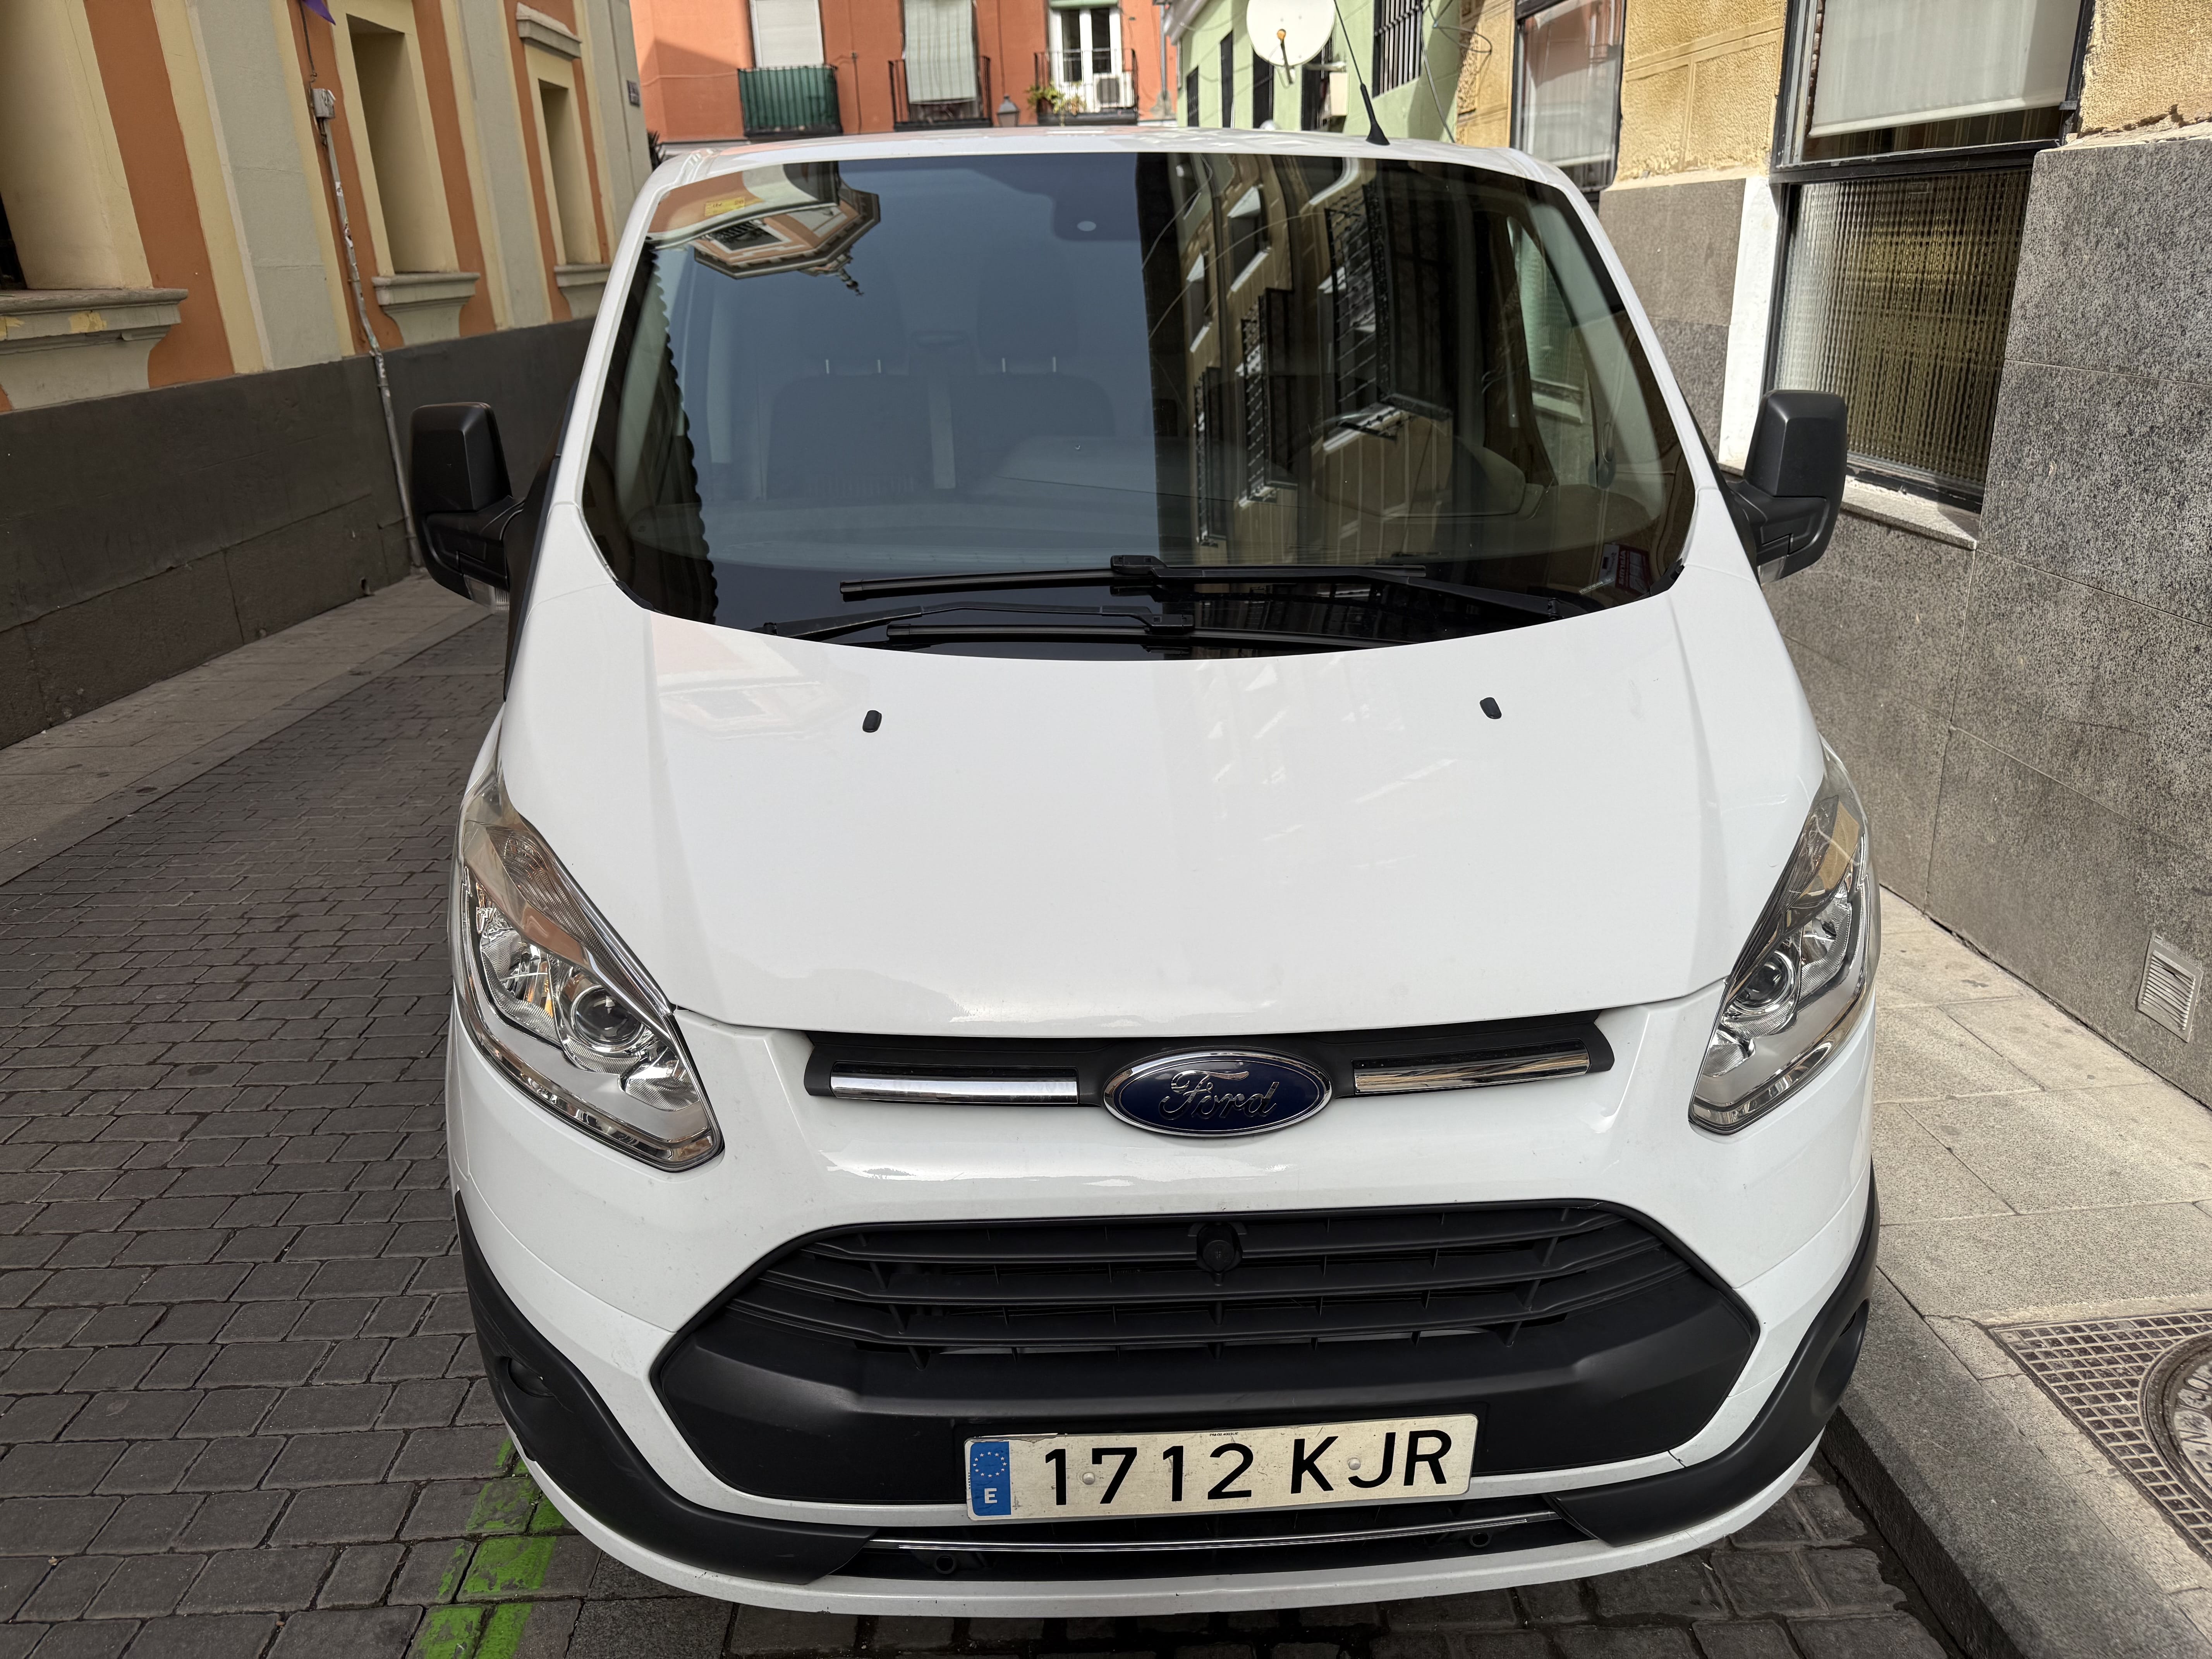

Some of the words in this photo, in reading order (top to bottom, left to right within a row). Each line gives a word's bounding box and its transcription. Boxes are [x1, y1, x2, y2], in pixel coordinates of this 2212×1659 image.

[1159, 1070, 1279, 1120] Ford
[1045, 1443, 1254, 1506] 1712
[1291, 1429, 1452, 1494] KJR
[984, 1488, 997, 1503] E
